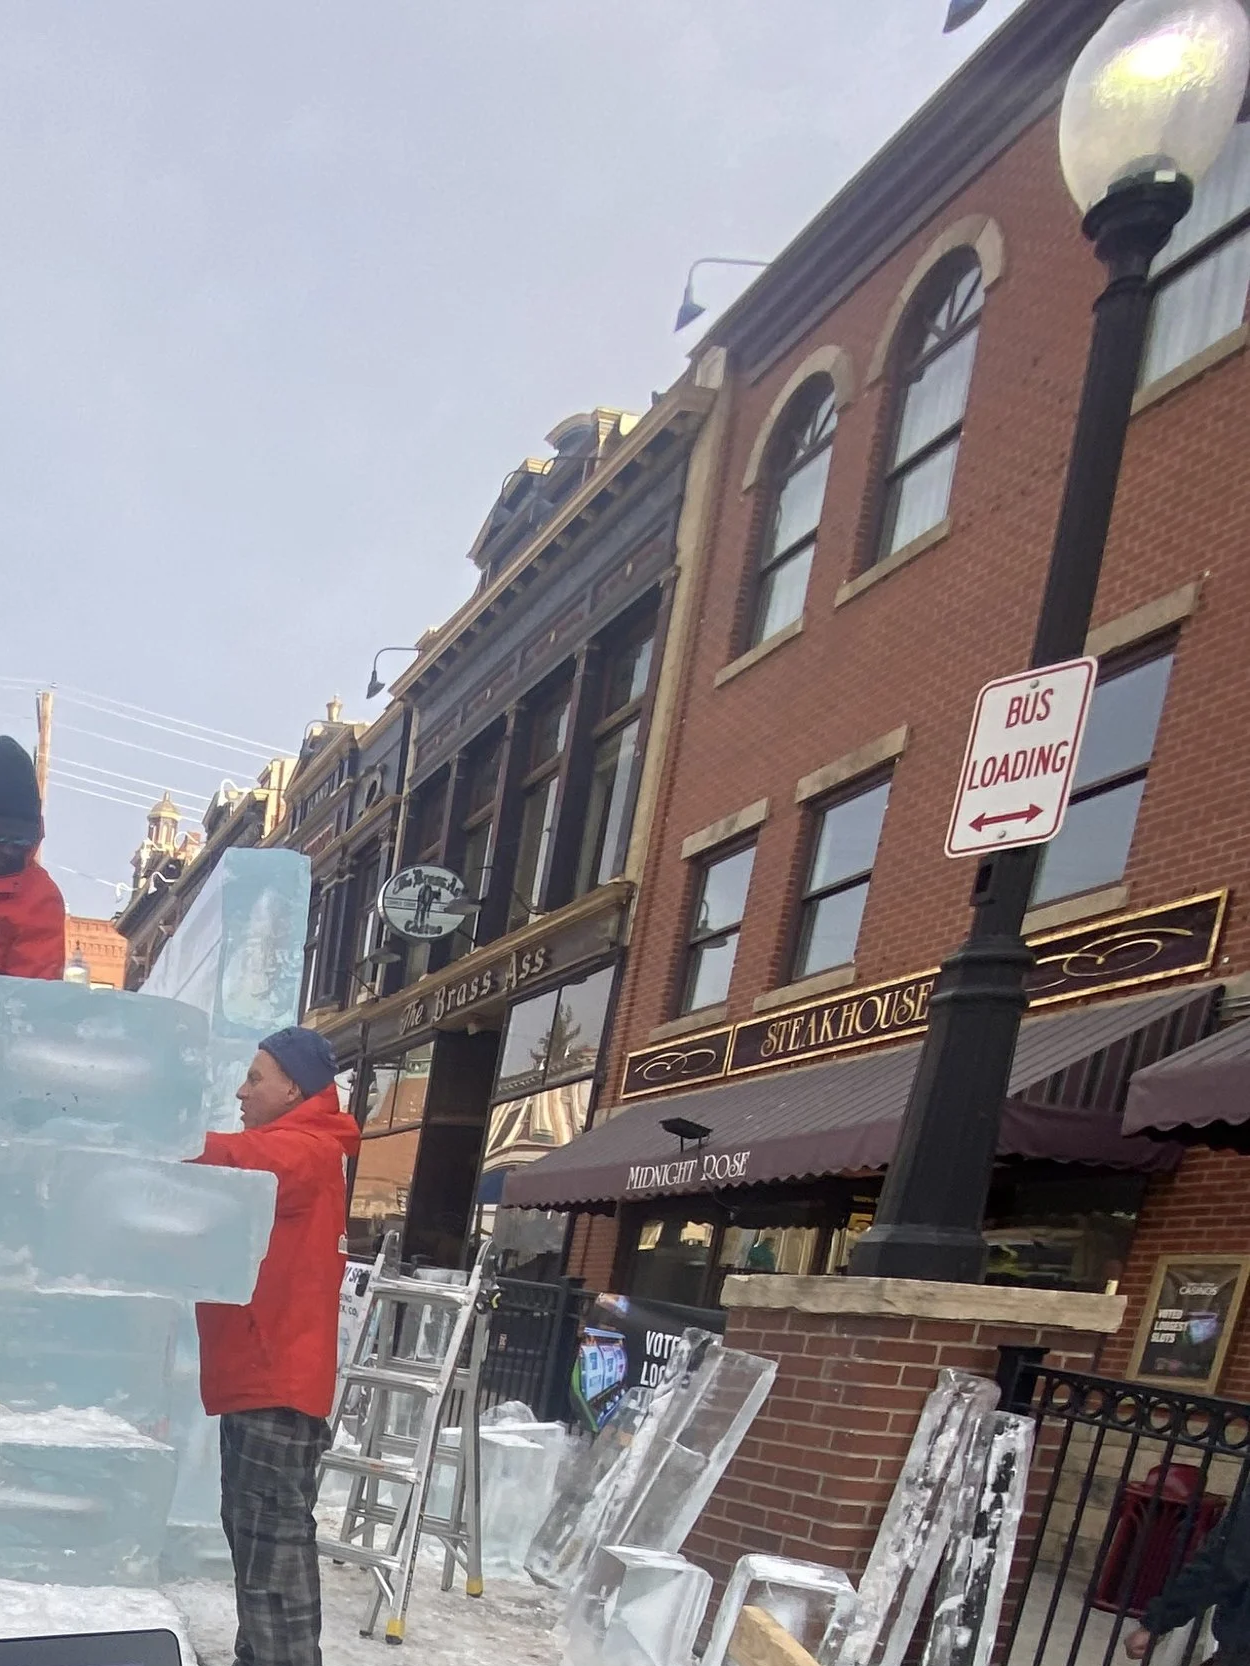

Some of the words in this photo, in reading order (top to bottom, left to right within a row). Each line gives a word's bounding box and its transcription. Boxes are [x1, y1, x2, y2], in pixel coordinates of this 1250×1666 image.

[1005, 688, 1054, 729] BUS
[967, 740, 1069, 791] LOADING
[400, 998, 425, 1035] The
[431, 970, 492, 1025] Brass
[501, 947, 547, 993] Ass
[760, 979, 935, 1058] STEAKHOUSE
[626, 1159, 698, 1190] MIDNIGHT
[700, 1150, 750, 1181] ROSE
[1179, 1286, 1219, 1296] CASINOS
[646, 1330, 682, 1360] VOTE
